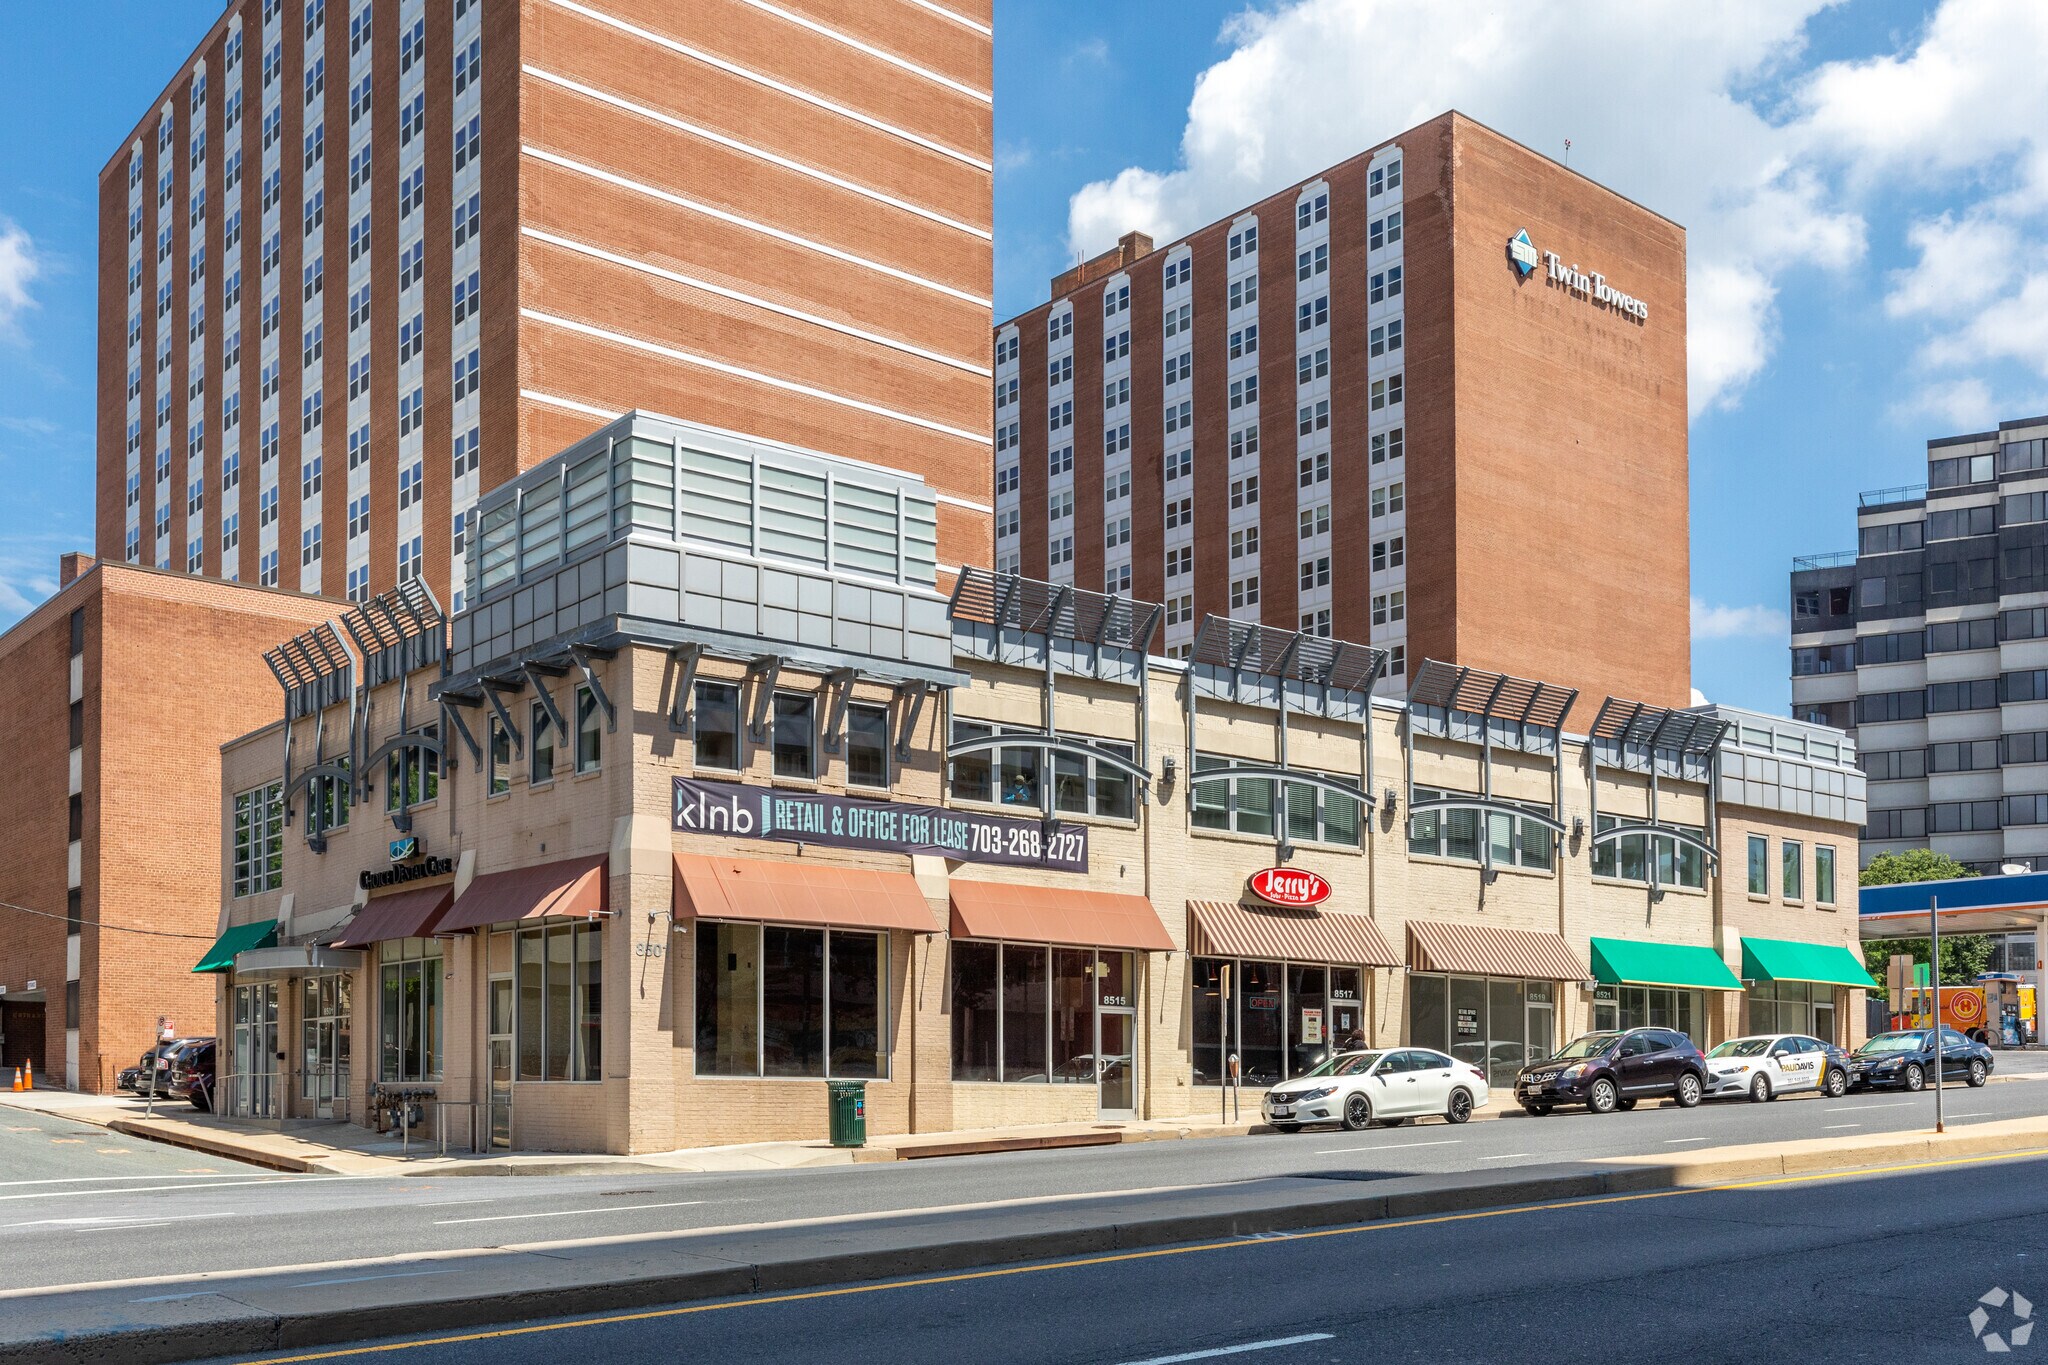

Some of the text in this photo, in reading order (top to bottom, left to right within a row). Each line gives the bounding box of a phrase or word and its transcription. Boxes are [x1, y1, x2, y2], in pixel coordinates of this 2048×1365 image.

[1544, 250, 1648, 319] Twin Towers
[677, 789, 754, 834] klnb
[775, 800, 1084, 862] RETAIL & OFFICE FOR LEASE 703-268-2727
[1265, 870, 1320, 901] Jerry's
[1334, 989, 1353, 999] 8517
[1529, 993, 1546, 1001] 8519
[1596, 990, 1611, 999] 8521
[1103, 995, 1126, 1005] 8515
[1251, 998, 1275, 1008] OPEN
